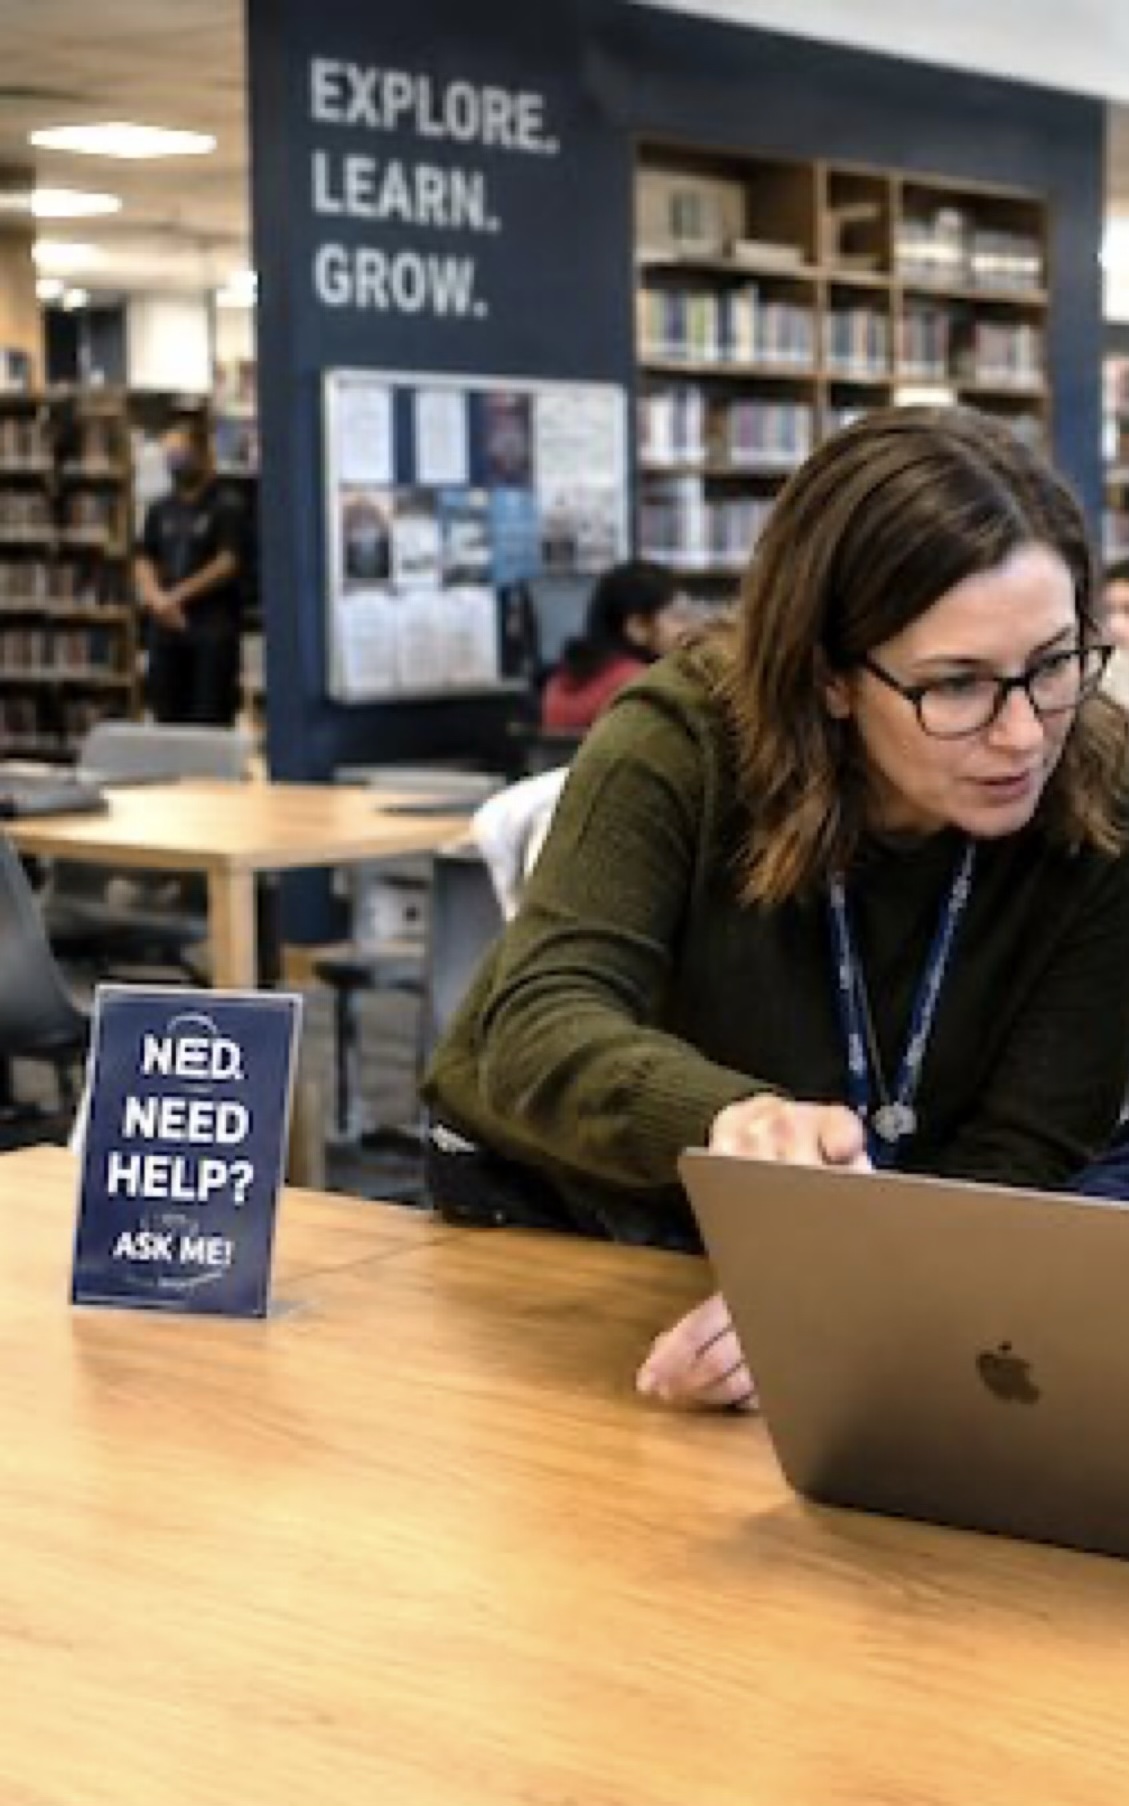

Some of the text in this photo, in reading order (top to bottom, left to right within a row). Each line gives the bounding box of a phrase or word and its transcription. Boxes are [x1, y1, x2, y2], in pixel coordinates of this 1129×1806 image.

[310, 57, 559, 154] EXPLORE.
[312, 151, 501, 233] LEARN.
[314, 242, 488, 318] GROW.
[123, 1096, 250, 1144] NEED
[106, 1151, 254, 1205] HELP?
[112, 1231, 233, 1266] ASK ME!
